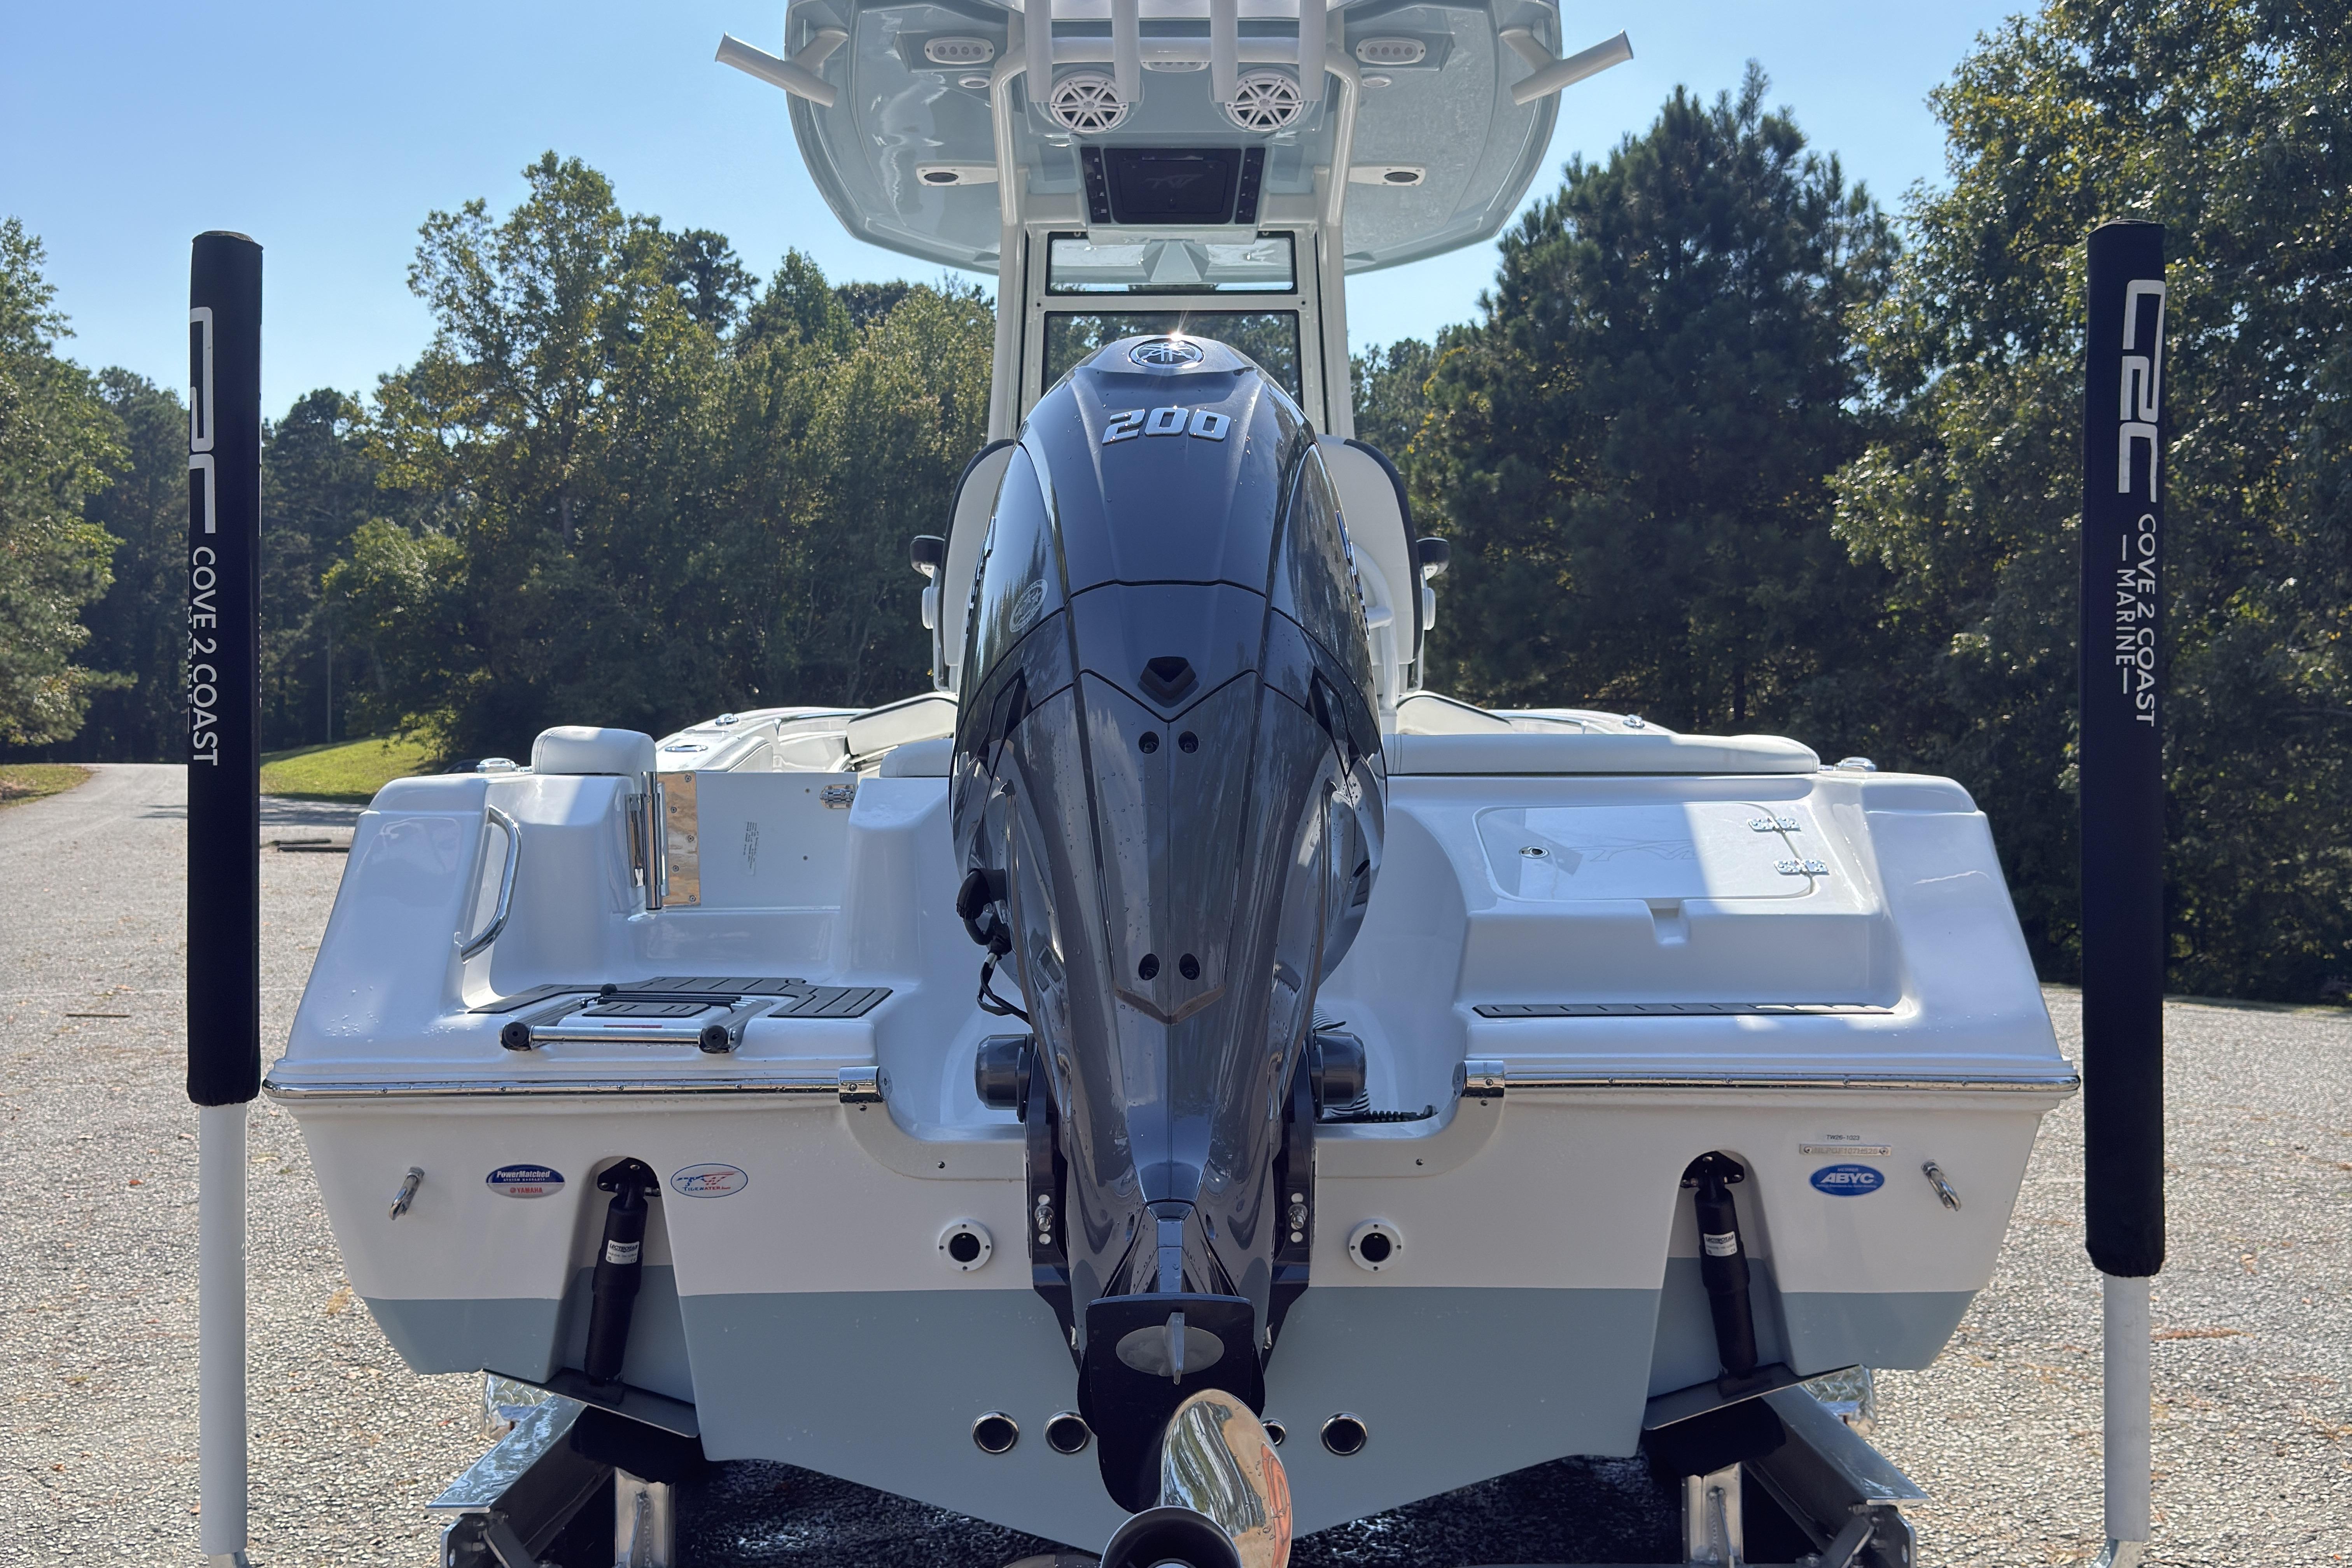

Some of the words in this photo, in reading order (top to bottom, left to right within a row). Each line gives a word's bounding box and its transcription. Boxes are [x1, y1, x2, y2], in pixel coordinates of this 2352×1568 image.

[1102, 407, 1231, 444] 200
[192, 546, 216, 629] COVE
[2137, 513, 2156, 595] COVE
[193, 638, 217, 655] 2
[2116, 569, 2136, 665] MARINE
[2137, 602, 2155, 619] 2
[193, 663, 218, 766] COAST
[2135, 627, 2155, 727] COAST
[1820, 1172, 1874, 1183] ABYC
